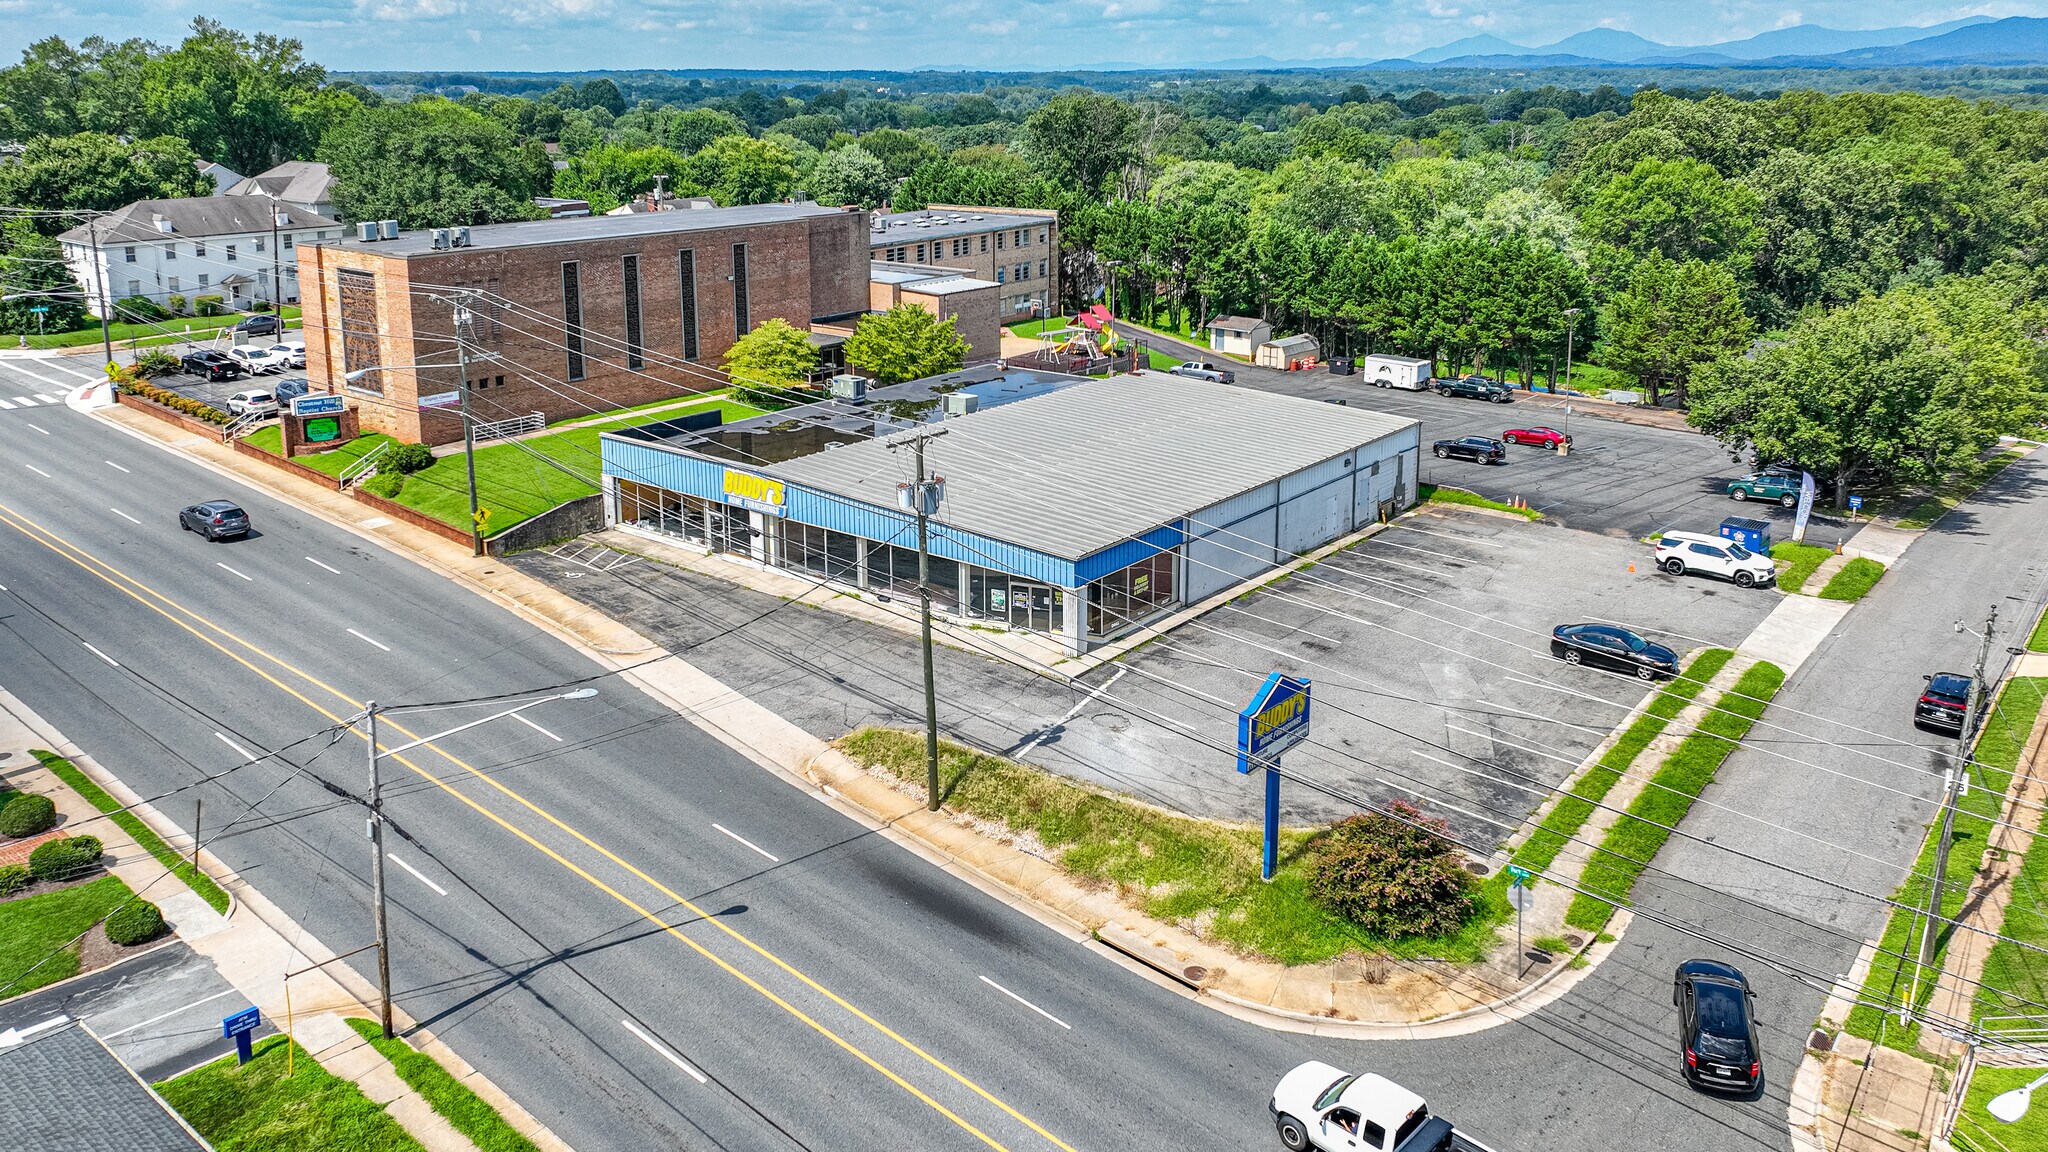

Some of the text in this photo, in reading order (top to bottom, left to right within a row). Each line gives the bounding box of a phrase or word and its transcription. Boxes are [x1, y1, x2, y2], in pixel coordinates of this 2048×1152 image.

[321, 404, 342, 412] Church
[724, 469, 783, 505] BUDDY'S
[728, 494, 780, 516] HOME FURNISHINGS
[1134, 574, 1148, 586] FREE
[1256, 688, 1307, 739] BUDDY'S
[1259, 731, 1274, 747] HOME
[230, 1016, 258, 1031] DRIVE THRU
[231, 1022, 256, 1036] ENTRANCE
